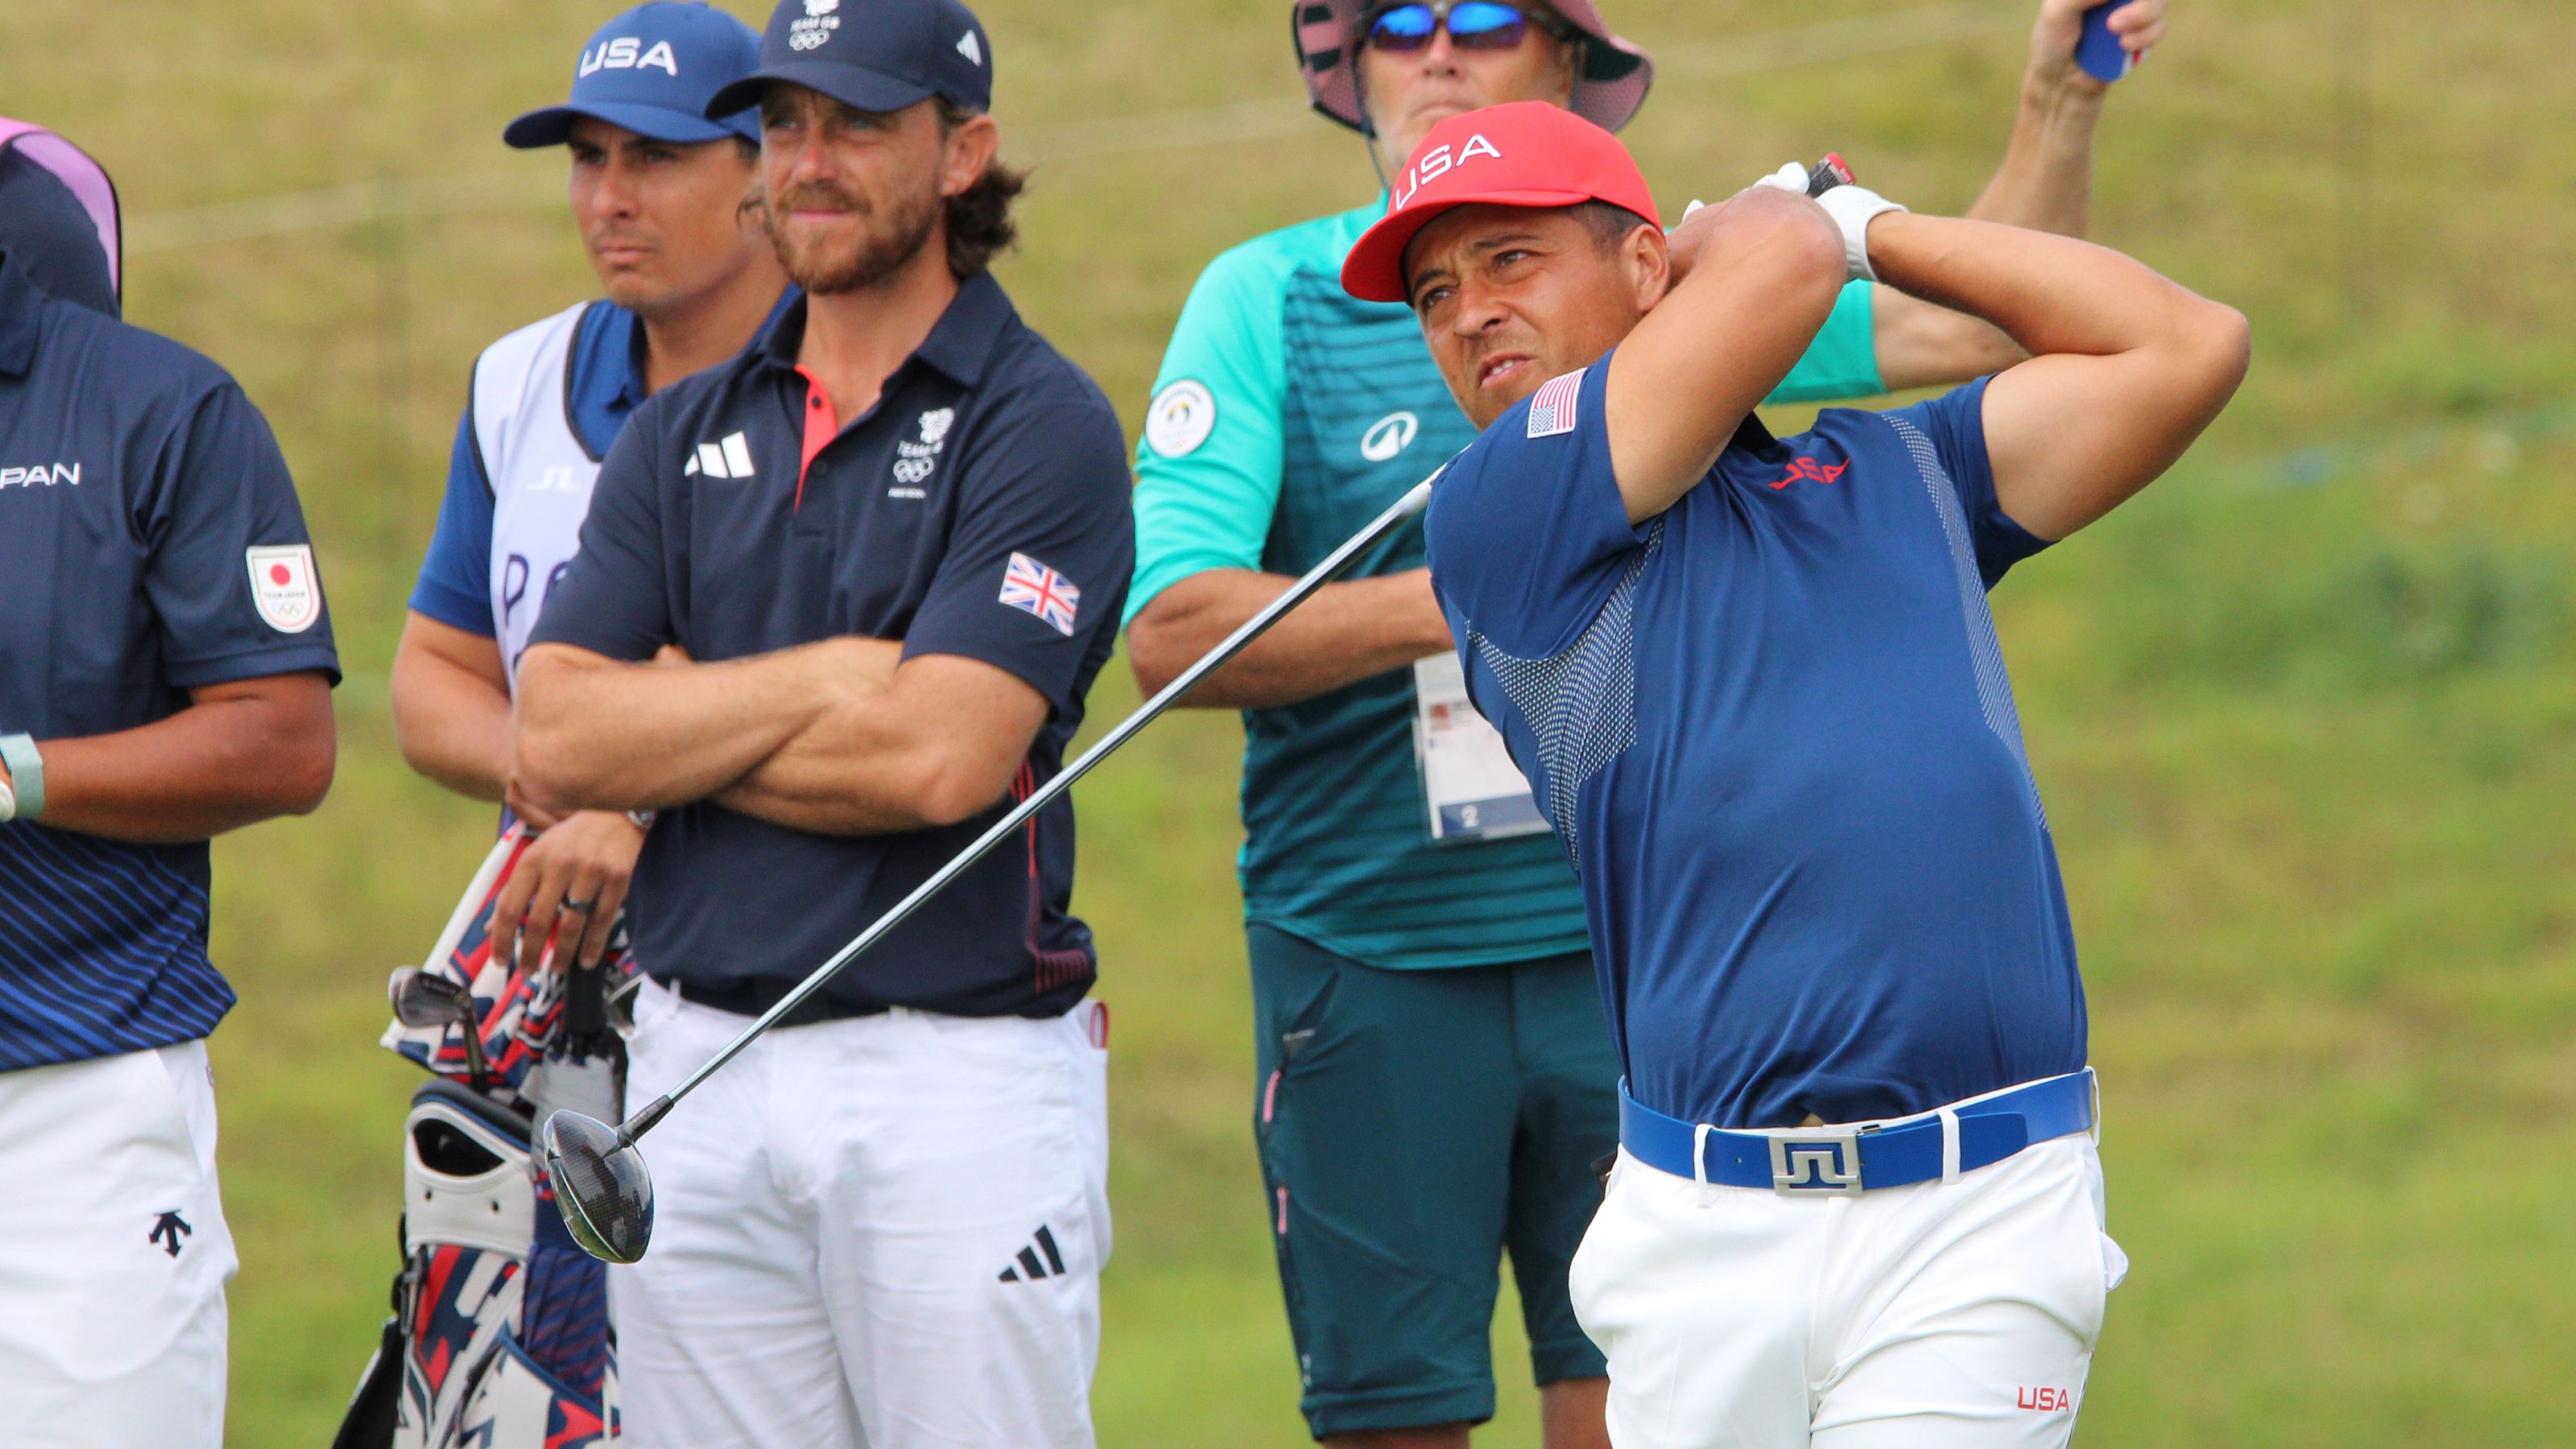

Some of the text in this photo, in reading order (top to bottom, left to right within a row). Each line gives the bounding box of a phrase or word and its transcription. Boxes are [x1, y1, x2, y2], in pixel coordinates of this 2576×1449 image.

[579, 37, 677, 79] USA
[1396, 138, 1502, 212] USA
[1768, 456, 1851, 490] USA
[1461, 804, 1479, 828] 2
[2017, 1385, 2069, 1413] USA
